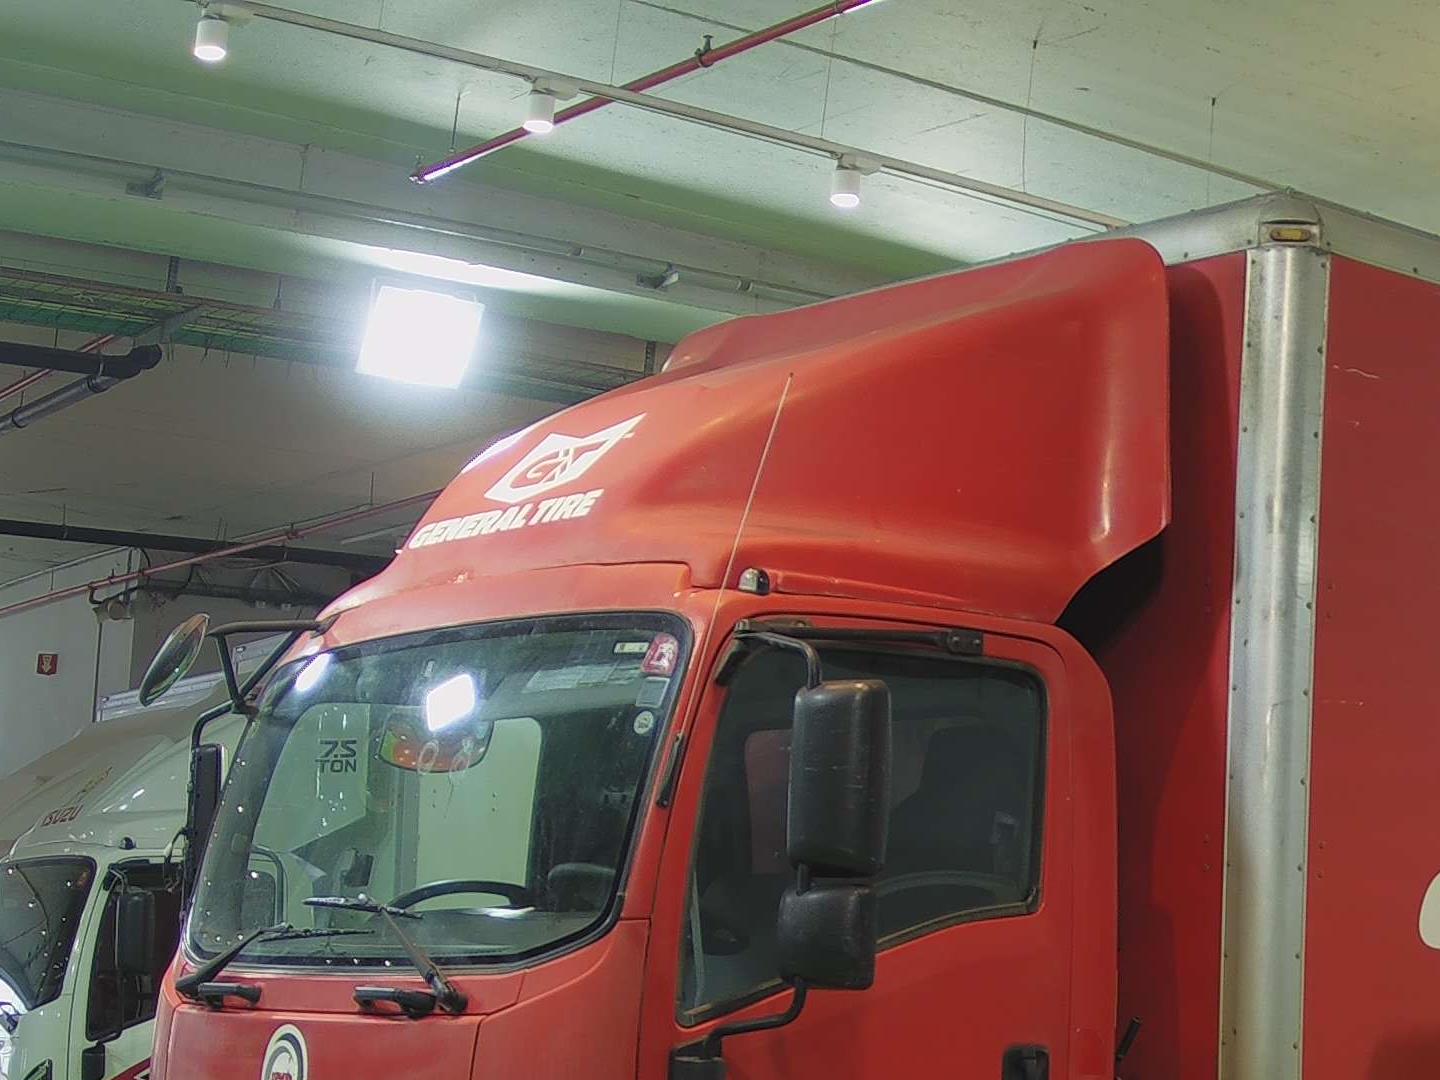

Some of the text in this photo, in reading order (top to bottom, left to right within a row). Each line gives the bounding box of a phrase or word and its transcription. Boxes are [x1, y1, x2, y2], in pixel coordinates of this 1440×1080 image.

[408, 488, 605, 550] GENERAL TIRE
[315, 759, 357, 773] TON
